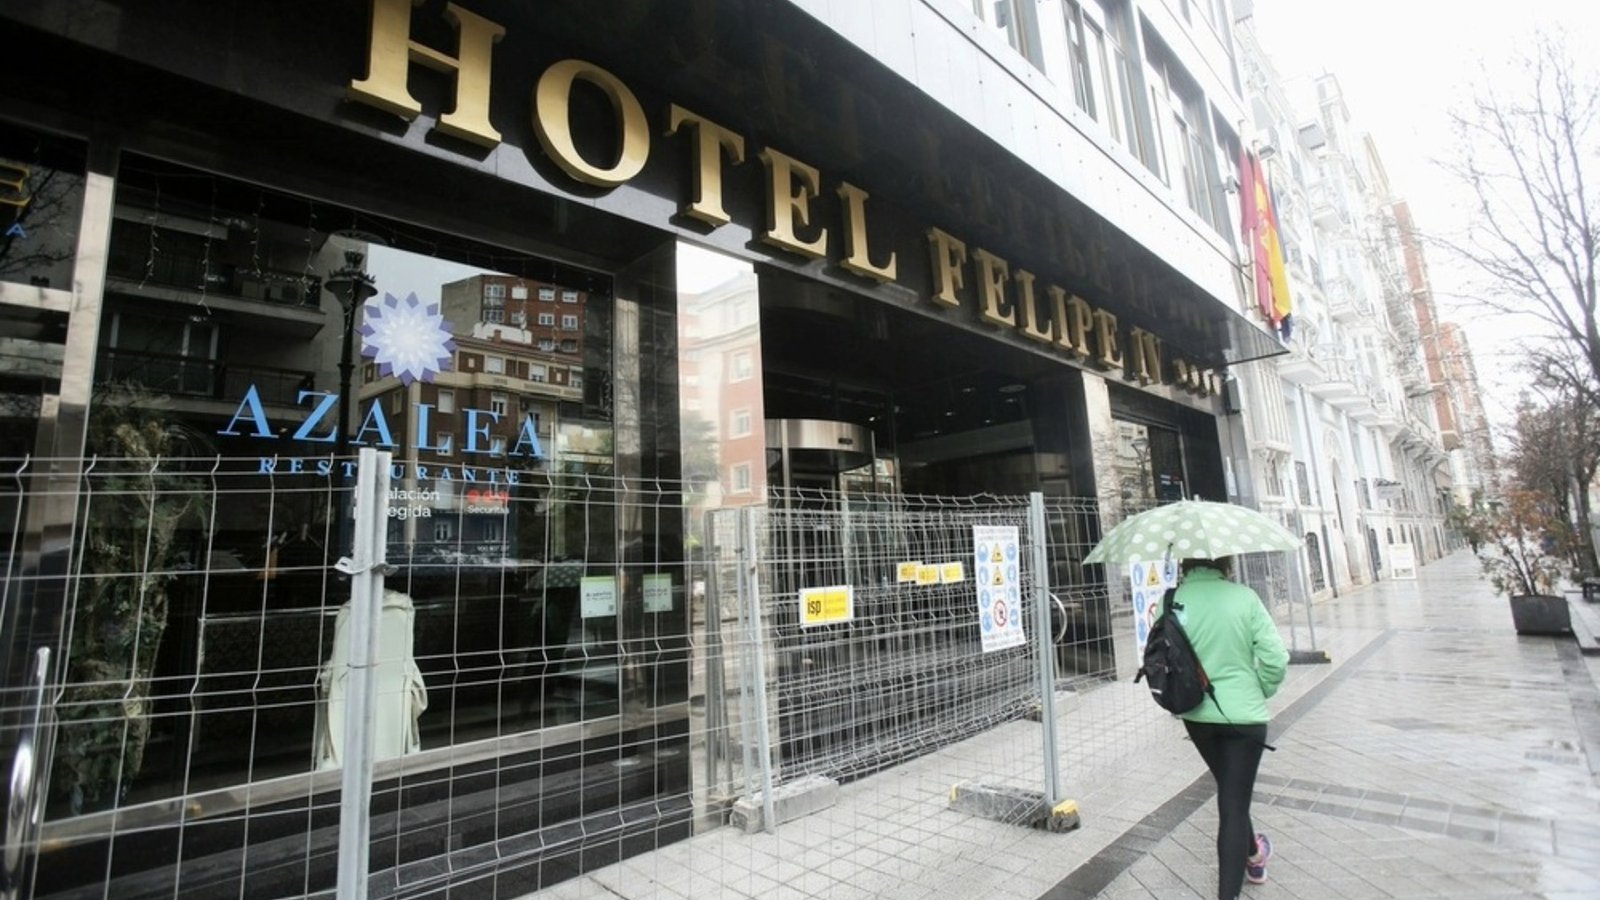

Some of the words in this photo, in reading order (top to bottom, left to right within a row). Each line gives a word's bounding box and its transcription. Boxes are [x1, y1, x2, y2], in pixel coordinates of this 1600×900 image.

[349, 0, 898, 284] HOTEL
[927, 226, 1124, 371] FELIPE
[1131, 325, 1163, 388] IV
[216, 383, 546, 458] AZALEA
[258, 455, 521, 485] RESTURANTE
[807, 597, 822, 616] isp
